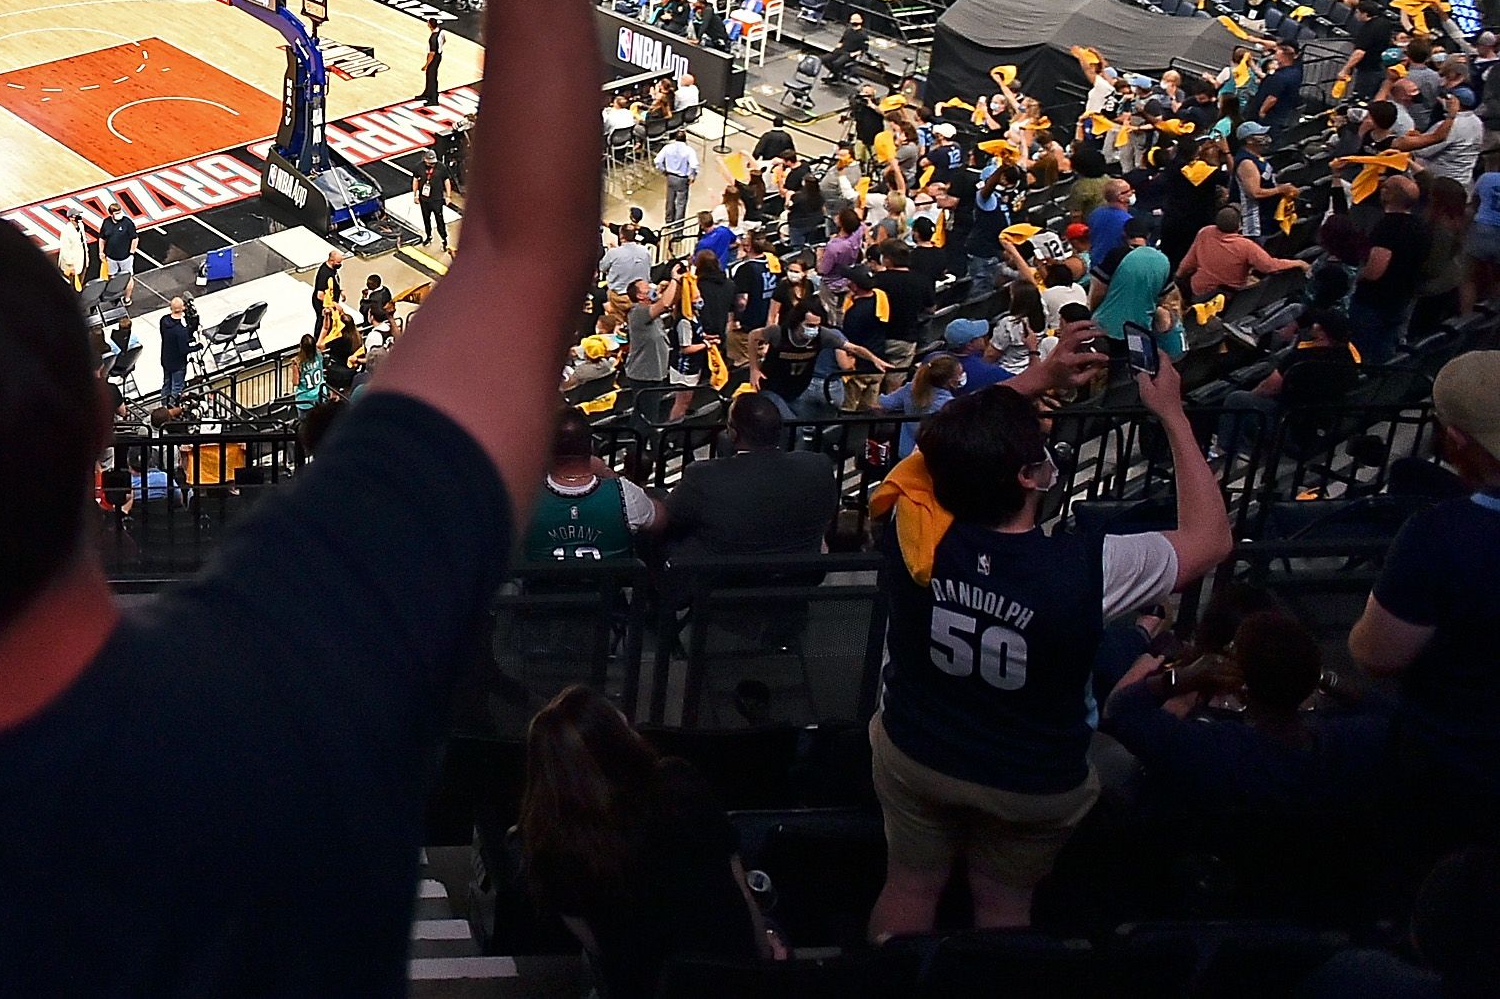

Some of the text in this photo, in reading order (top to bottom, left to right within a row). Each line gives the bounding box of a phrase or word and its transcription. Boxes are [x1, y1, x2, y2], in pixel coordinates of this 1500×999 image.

[631, 31, 689, 86] NBA App
[948, 149, 961, 164] 12
[275, 170, 308, 209] NBA App
[1044, 239, 1064, 258] 12
[304, 369, 321, 389] 10
[548, 525, 603, 543] MORANT
[931, 578, 1034, 629] RANDOLPH
[930, 606, 1028, 691] 50
